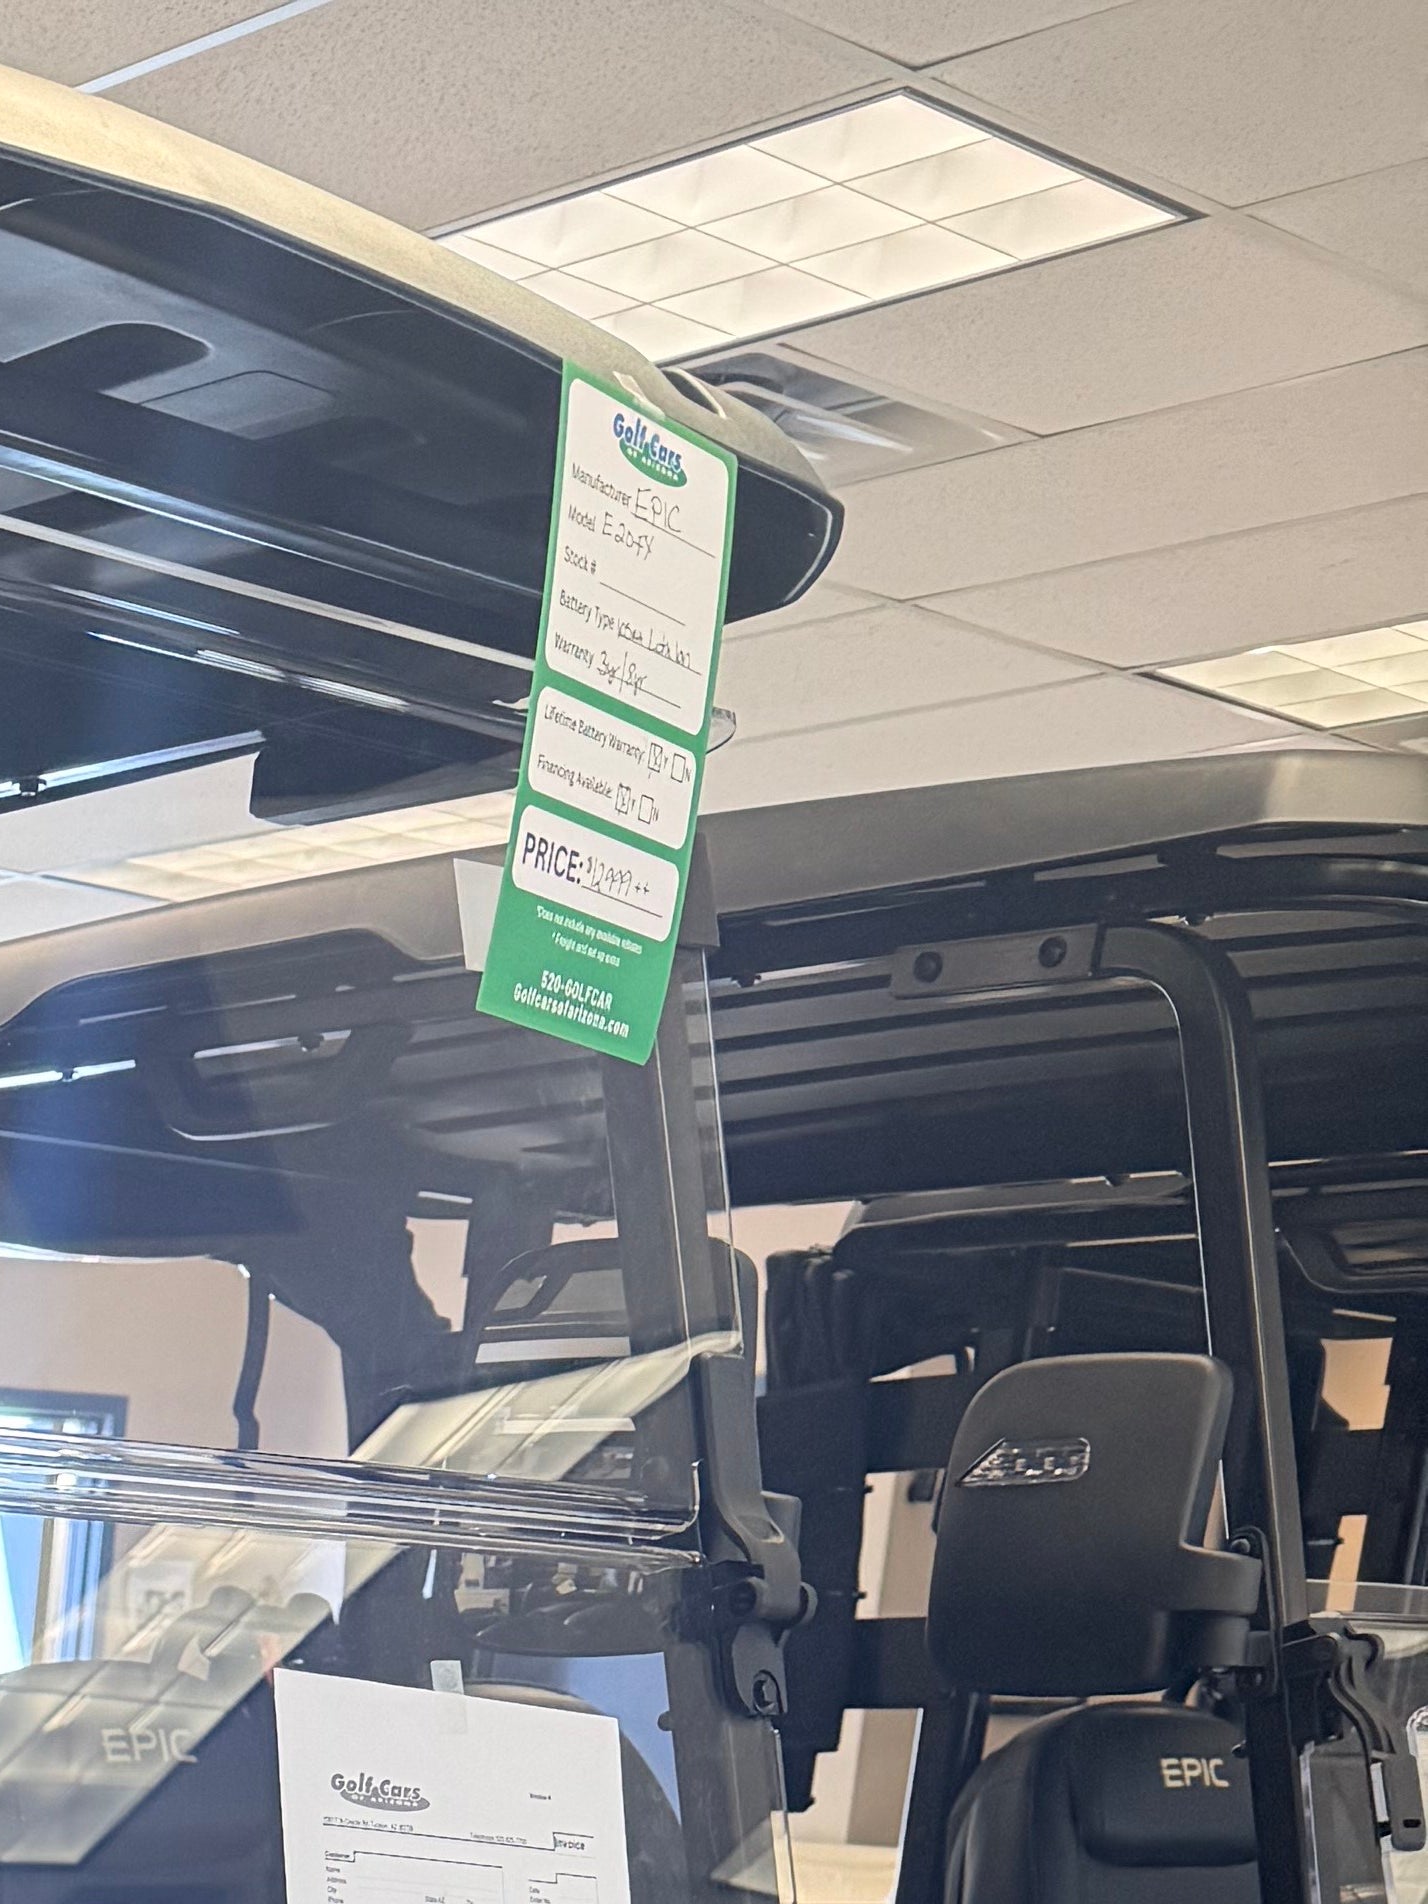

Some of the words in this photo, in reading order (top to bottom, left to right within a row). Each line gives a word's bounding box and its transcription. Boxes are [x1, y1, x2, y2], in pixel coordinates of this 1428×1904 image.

[613, 413, 646, 453] Golf
[649, 433, 682, 470] Cars
[573, 463, 632, 508] Manufacturer
[568, 504, 596, 532] Model
[635, 488, 682, 533] EPIC
[564, 545, 589, 573] Stock
[560, 589, 592, 622] Battery
[595, 605, 615, 632] Type
[554, 631, 594, 668] Warranty
[578, 716, 607, 748] Battery
[521, 832, 583, 885] PRICE:
[514, 983, 630, 1038] Golfcarsofarizona.com
[541, 970, 613, 1012] 520-GOLFCAR
[100, 1727, 199, 1765] EPIC
[331, 1772, 373, 1793] Golf
[379, 1780, 421, 1799] Cars
[1160, 1758, 1230, 1790] EPIC
